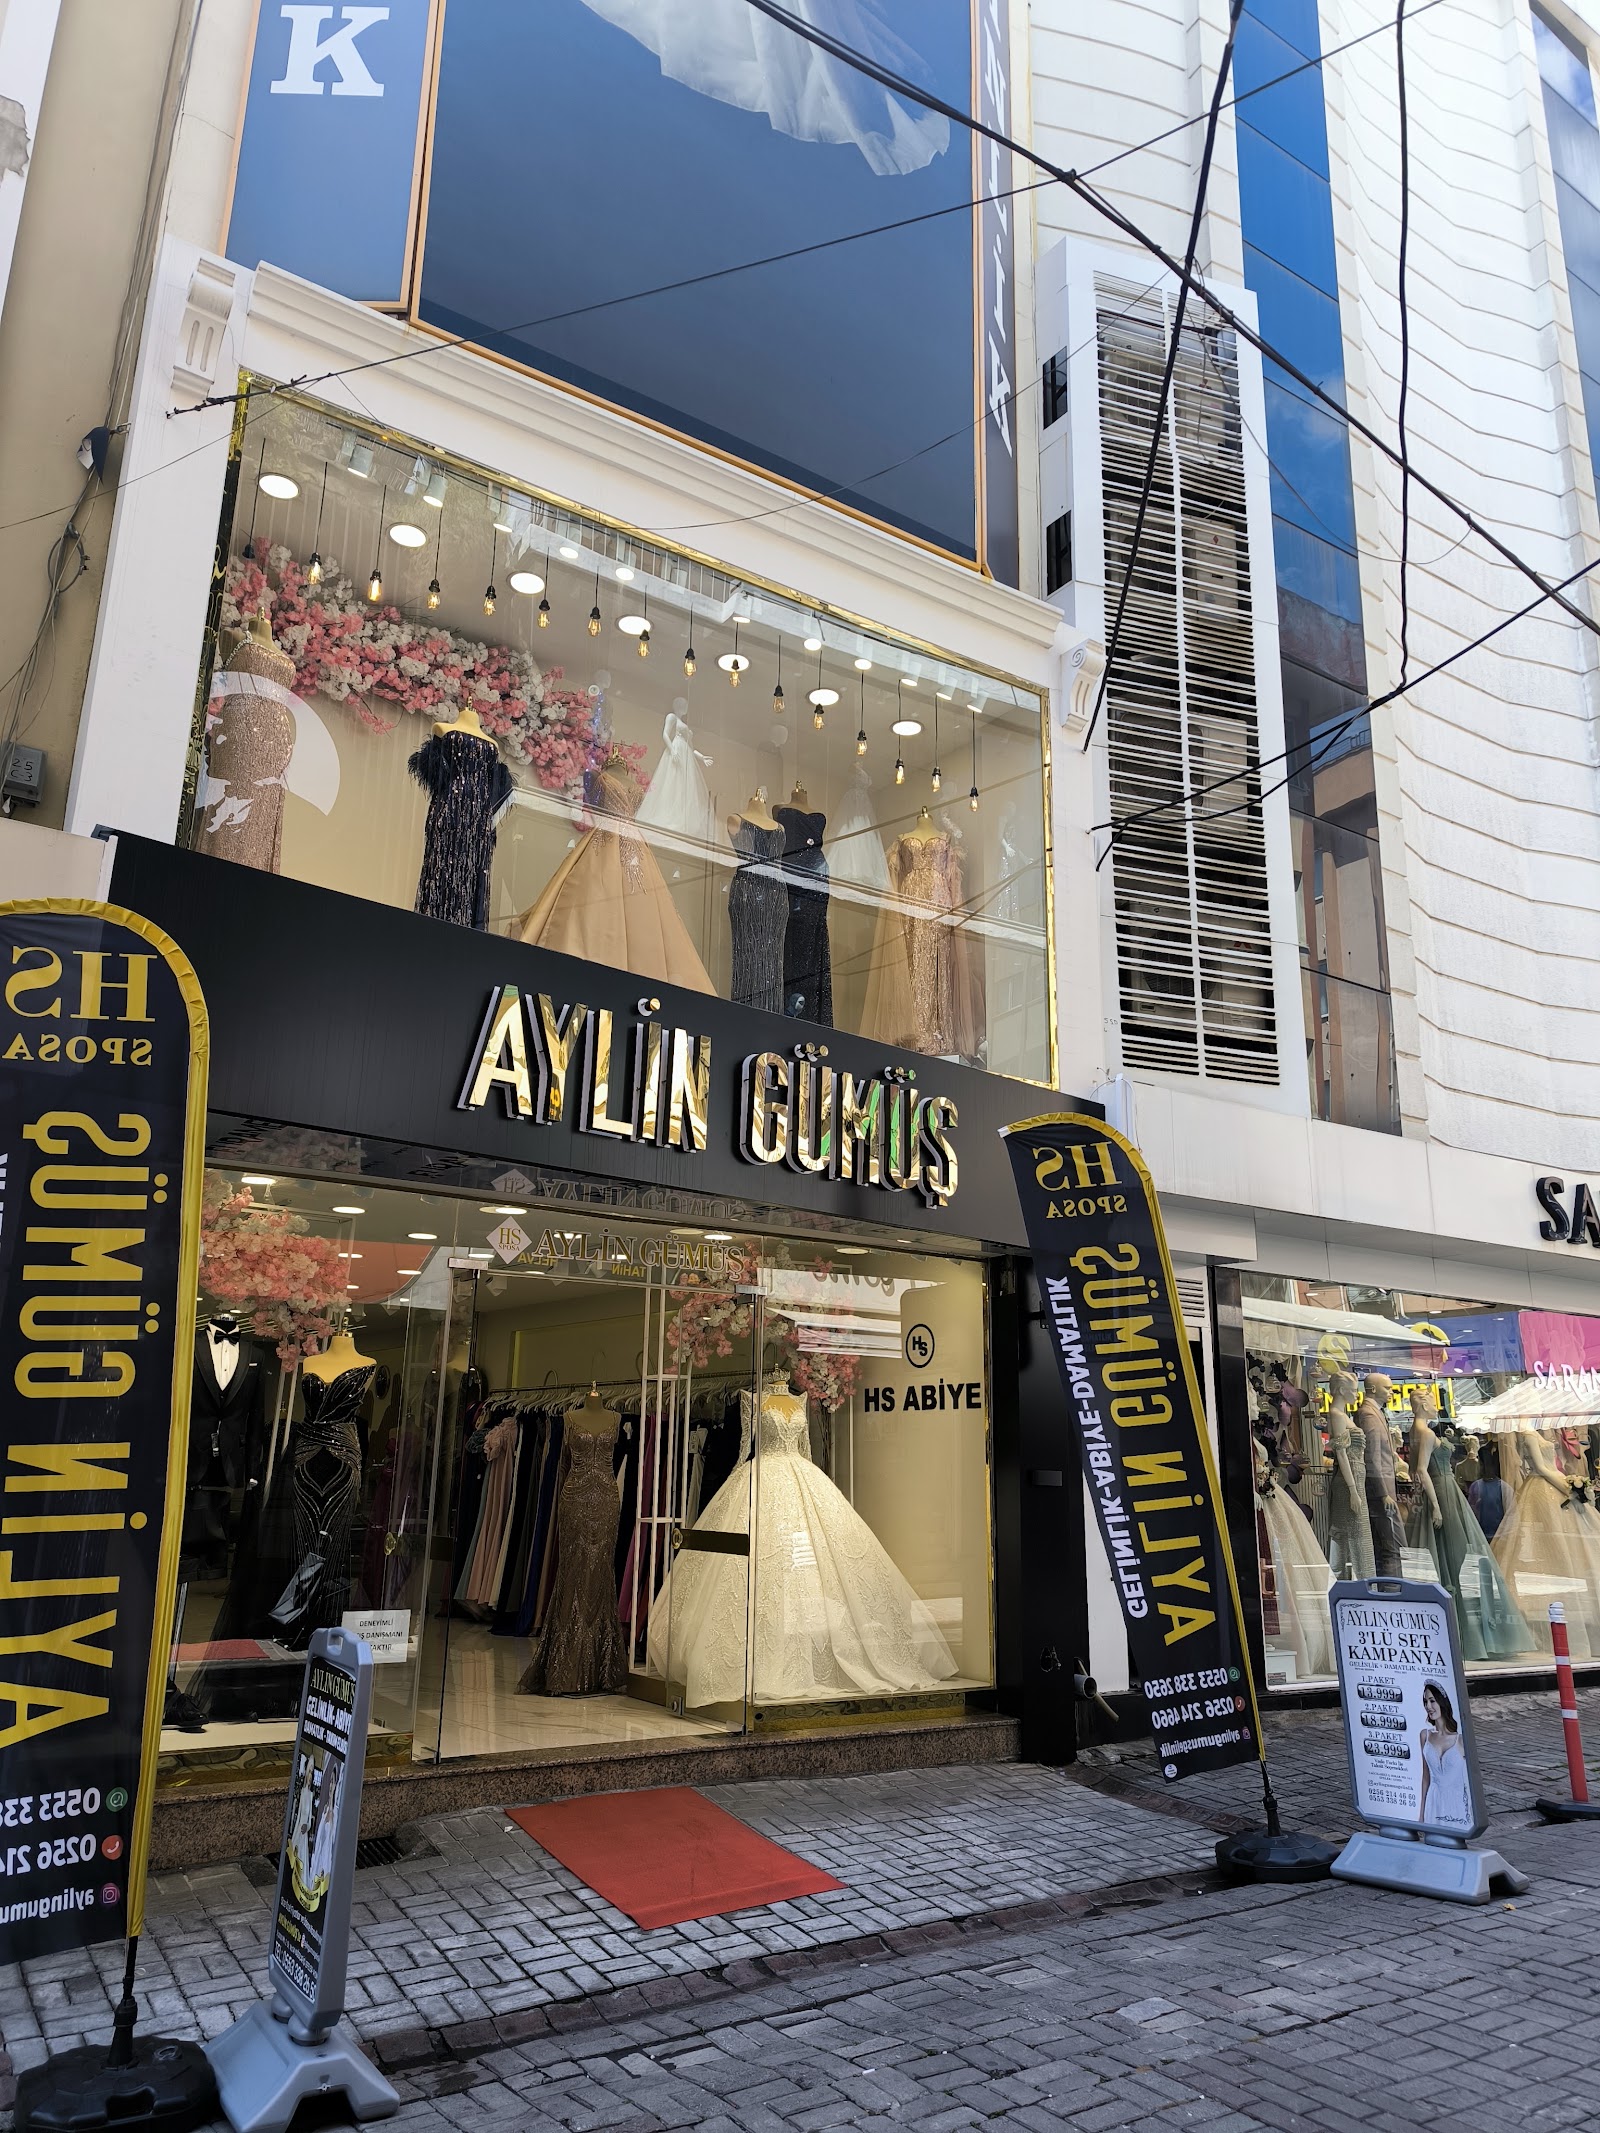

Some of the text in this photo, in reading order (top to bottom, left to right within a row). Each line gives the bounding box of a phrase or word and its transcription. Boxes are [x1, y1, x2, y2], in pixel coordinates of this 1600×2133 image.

[270, 4, 391, 97] K
[457, 984, 960, 1210] AYLİN GÜMÜŞ
[498, 1243, 520, 1251] SPOSA
[500, 1227, 521, 1246] HS
[532, 1228, 745, 1281] AYLİN GÜMÜŞ
[912, 1336, 928, 1357] HS
[864, 1378, 982, 1412] HS ABİYE
[1346, 1608, 1440, 1635] AYLİN GÜMÜŞ
[1358, 1628, 1431, 1648] 3'LÜ SET
[1348, 1645, 1446, 1666] KAMPANYA
